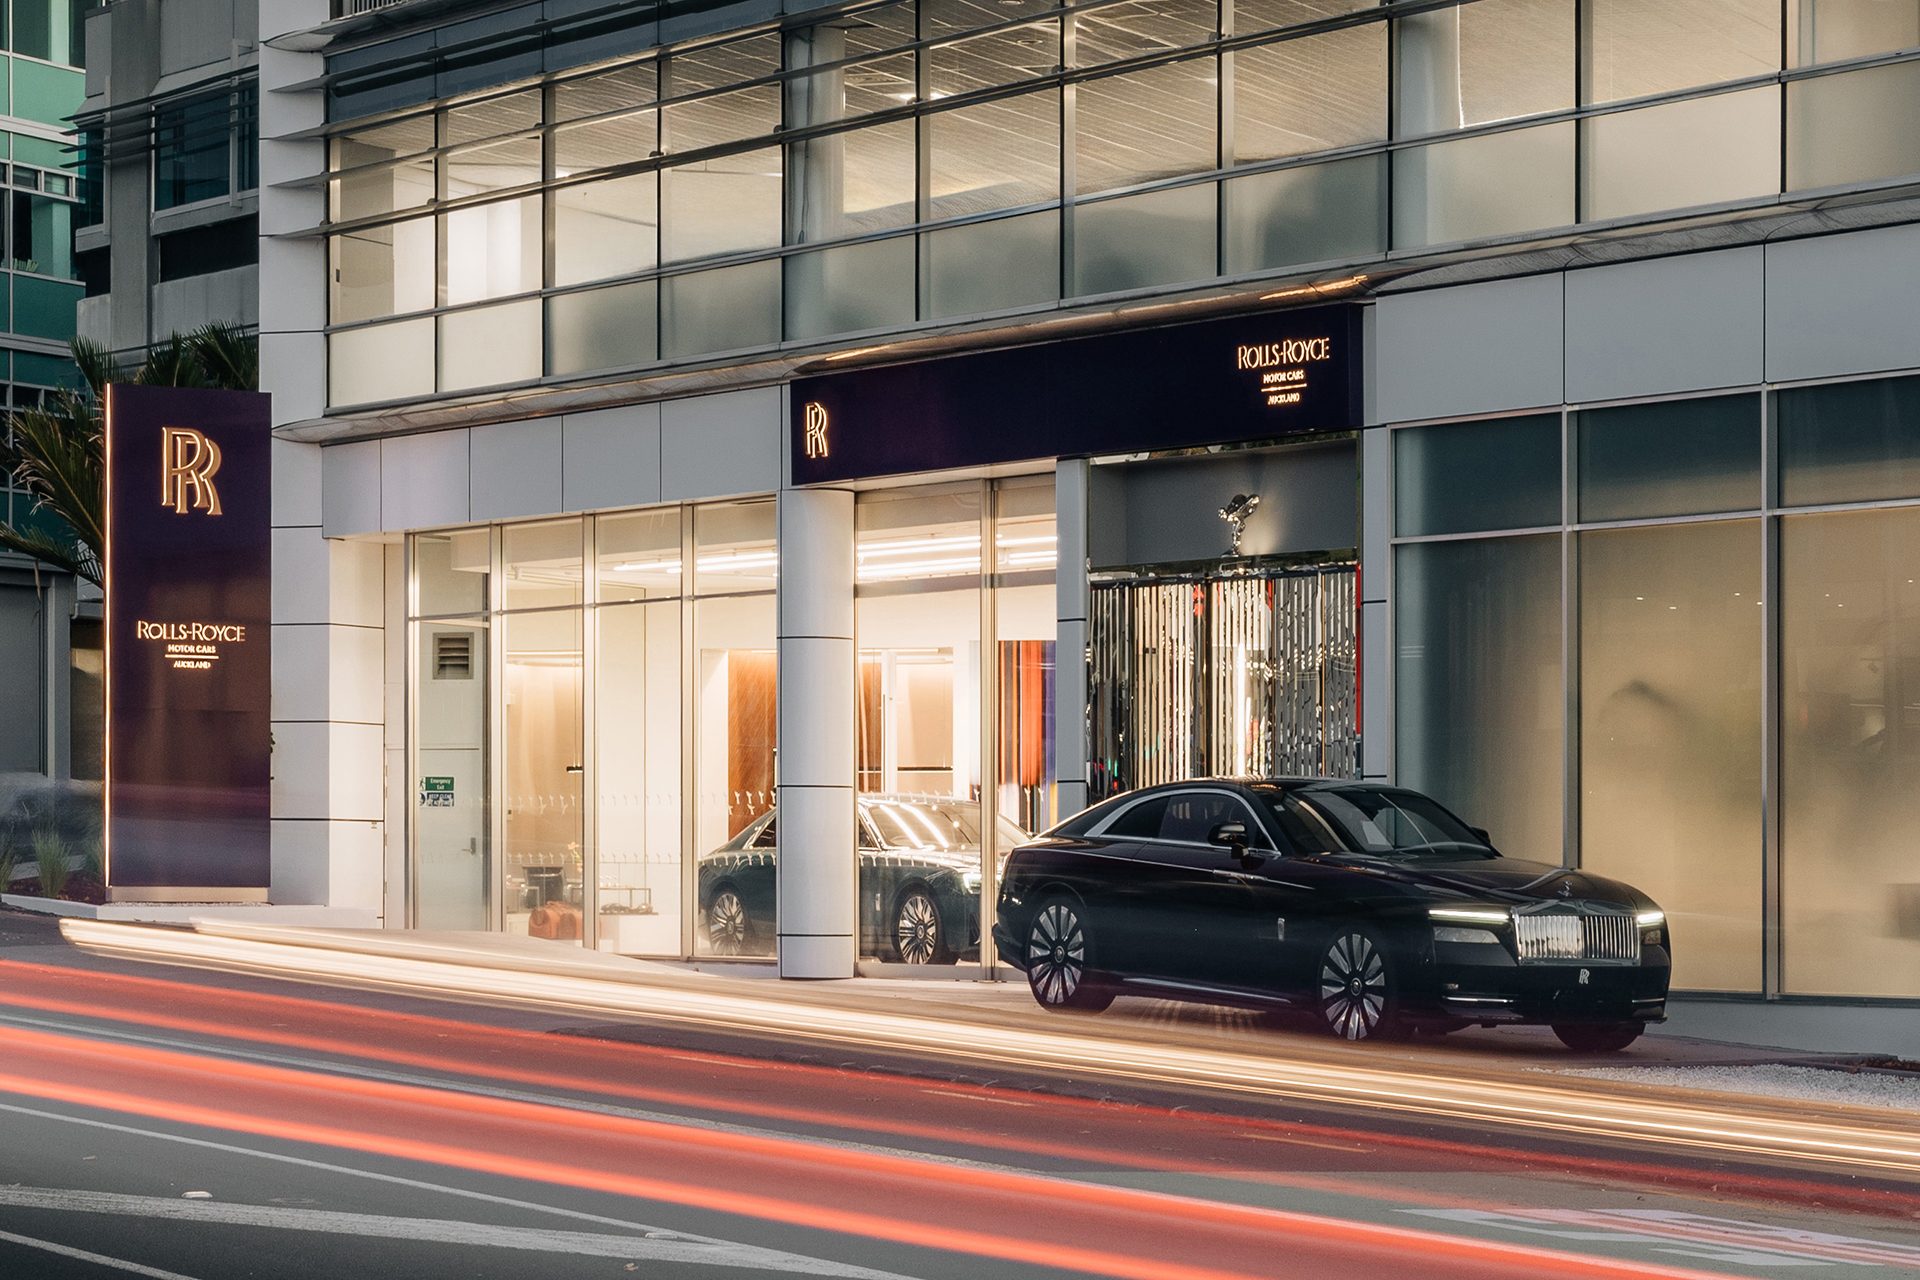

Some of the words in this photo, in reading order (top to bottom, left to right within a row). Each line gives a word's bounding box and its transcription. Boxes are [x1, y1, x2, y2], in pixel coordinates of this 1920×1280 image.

[1238, 338, 1330, 369] ROLLS-ROYCE
[1263, 373, 1286, 384] MOTOR
[1287, 370, 1304, 381] CARS
[161, 427, 223, 516] RR
[137, 620, 246, 642] ROLLS-ROYCE
[167, 644, 195, 653] MOTOR
[196, 645, 216, 653] CARS
[173, 661, 211, 669] AUCKLAND
